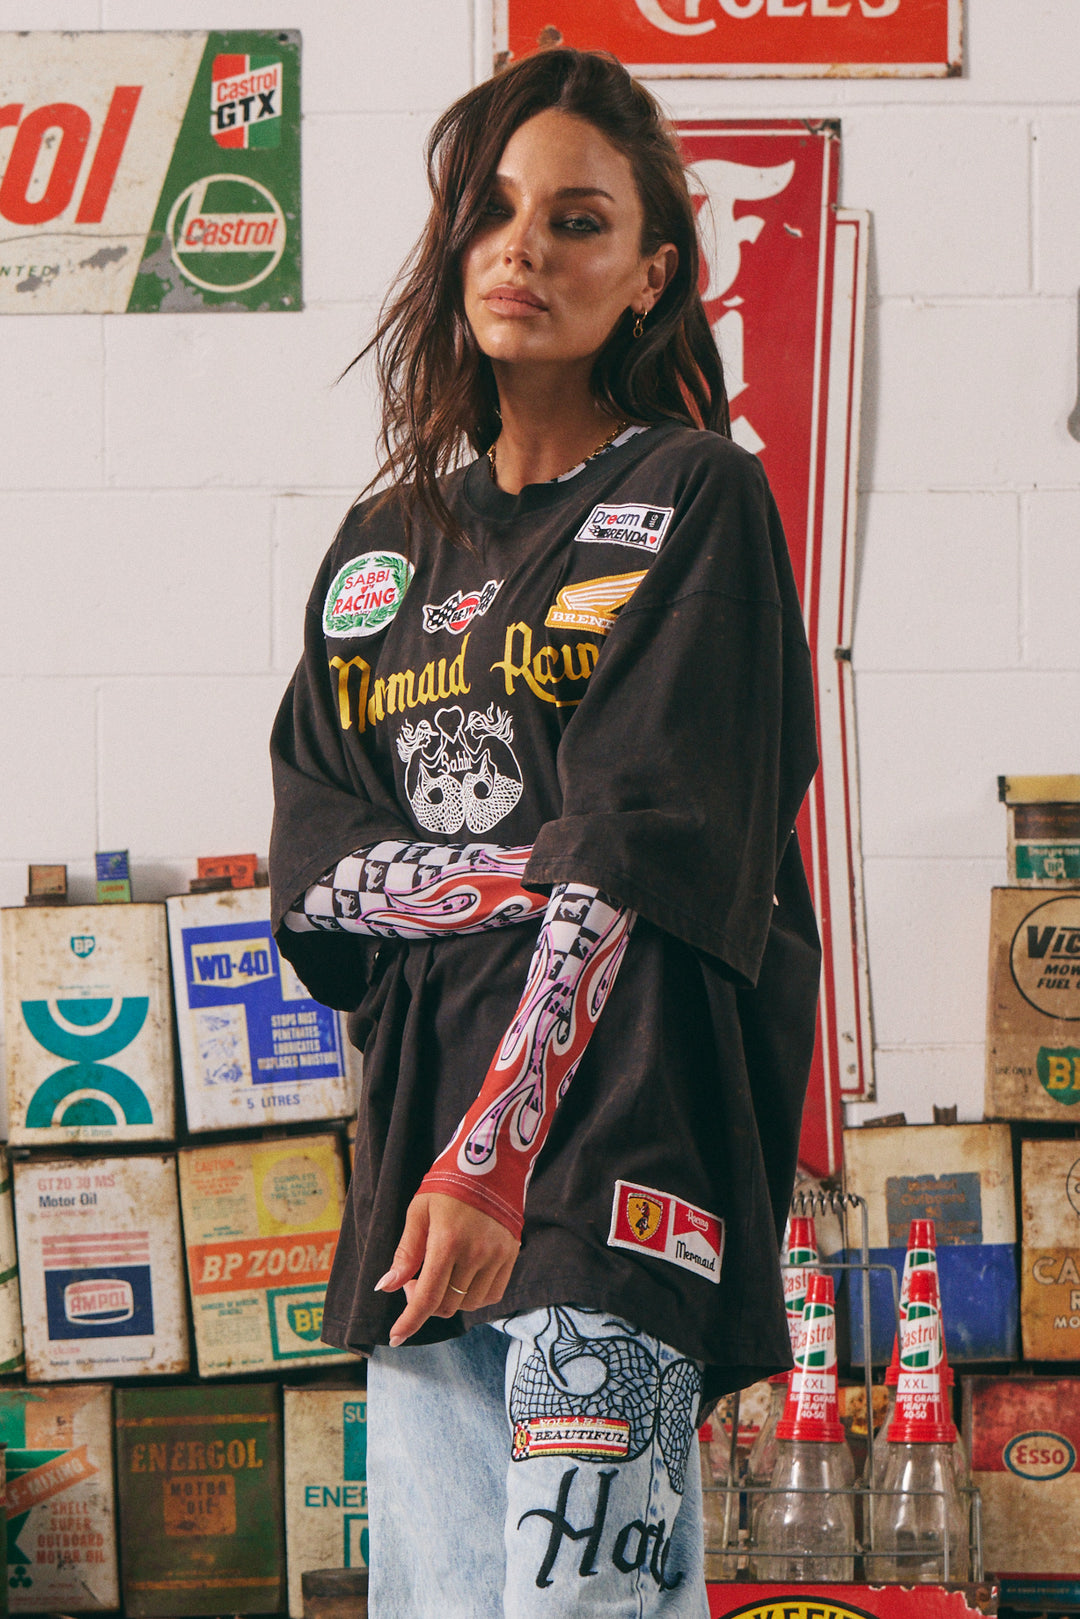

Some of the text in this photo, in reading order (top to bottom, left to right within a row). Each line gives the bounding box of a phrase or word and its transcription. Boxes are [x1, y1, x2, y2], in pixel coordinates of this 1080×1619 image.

[217, 68, 277, 103] Castrol
[217, 89, 275, 129] GTX
[184, 218, 278, 246] Castrol
[592, 511, 641, 527] Dream
[605, 527, 648, 546] BRENDA
[344, 569, 390, 590] SABBI
[331, 587, 397, 616] RACING
[74, 938, 94, 954] BP
[1037, 977, 1070, 990] FUEL
[247, 1094, 300, 1110] 5 LITRES
[39, 1192, 97, 1208] Motor Oil
[199, 1242, 335, 1283] BP ZOOM
[675, 1240, 716, 1272] Mermaid
[70, 1291, 129, 1313] AMPOL
[797, 1322, 835, 1350] Castrol
[904, 1379, 928, 1389] XXL
[903, 1402, 927, 1411] HEAVY
[914, 1394, 940, 1403] GRADE
[539, 1416, 606, 1427] YOU ARE
[801, 1410, 825, 1419] 40-50
[903, 1410, 927, 1419] 40-50
[534, 1429, 629, 1444] BEAUTIFUL
[131, 1438, 263, 1473] ENERGOL
[171, 1480, 227, 1496] MOTOR
[51, 1502, 88, 1515] SHELL
[187, 1500, 213, 1515] OIL
[50, 1518, 92, 1531] SUPER
[37, 1534, 104, 1548] OUTBOARD
[86, 1550, 106, 1564] OIL
